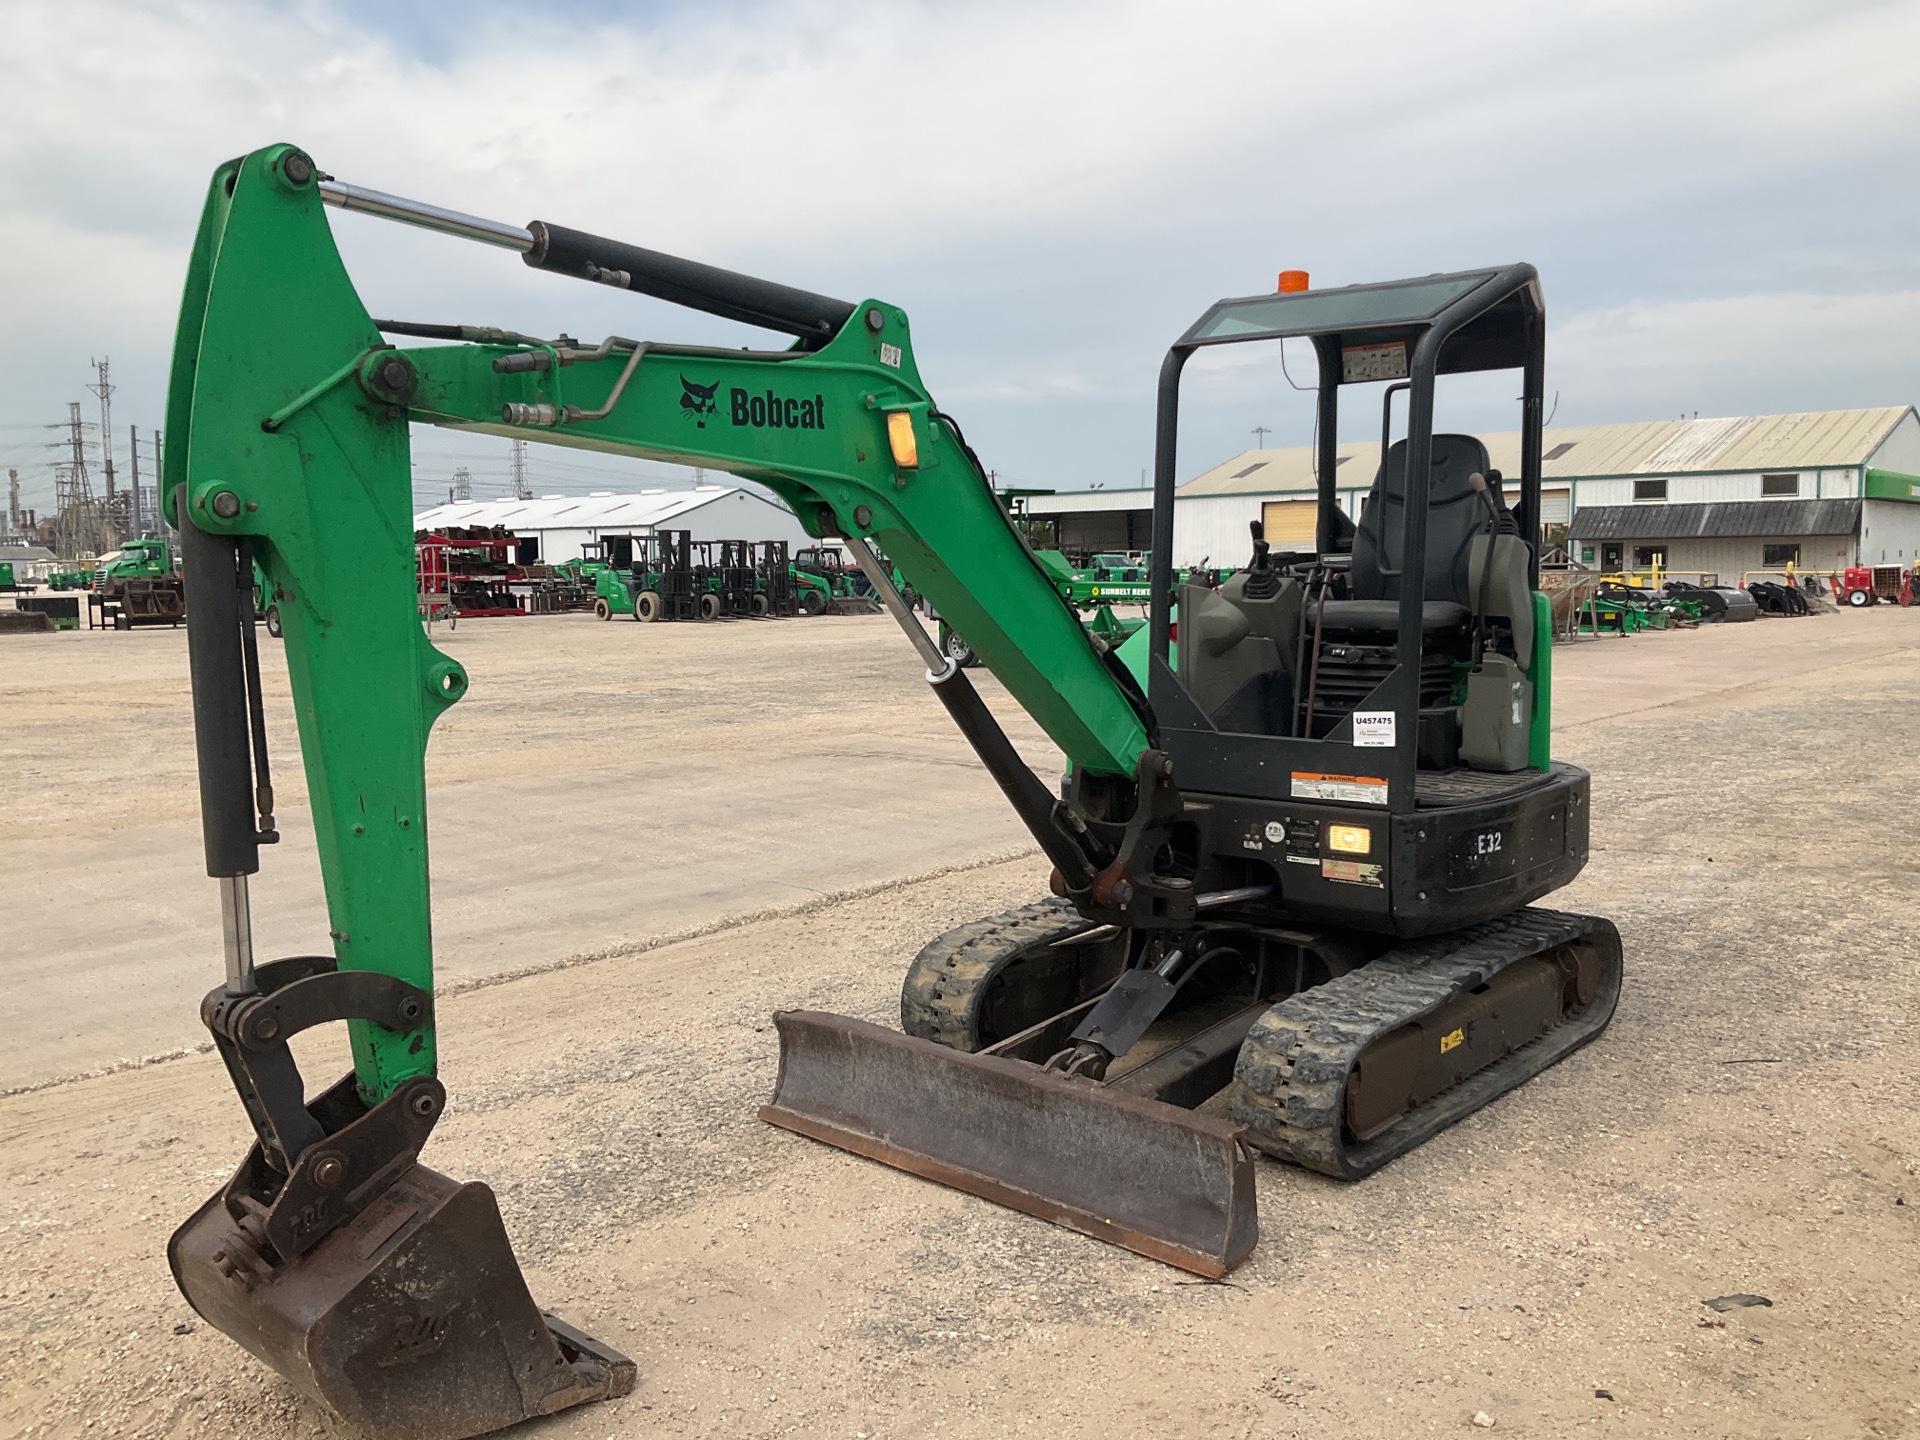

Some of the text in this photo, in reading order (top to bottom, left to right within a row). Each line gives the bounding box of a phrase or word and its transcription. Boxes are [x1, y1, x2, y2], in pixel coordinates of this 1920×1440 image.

[730, 387, 825, 430] Bobcat
[1100, 587, 1151, 596] SUNBELT RENT
[1355, 717, 1392, 725] U457475
[1328, 775, 1357, 783] WARNING
[1268, 826, 1281, 834] PDI
[1478, 831, 1502, 854] E32
